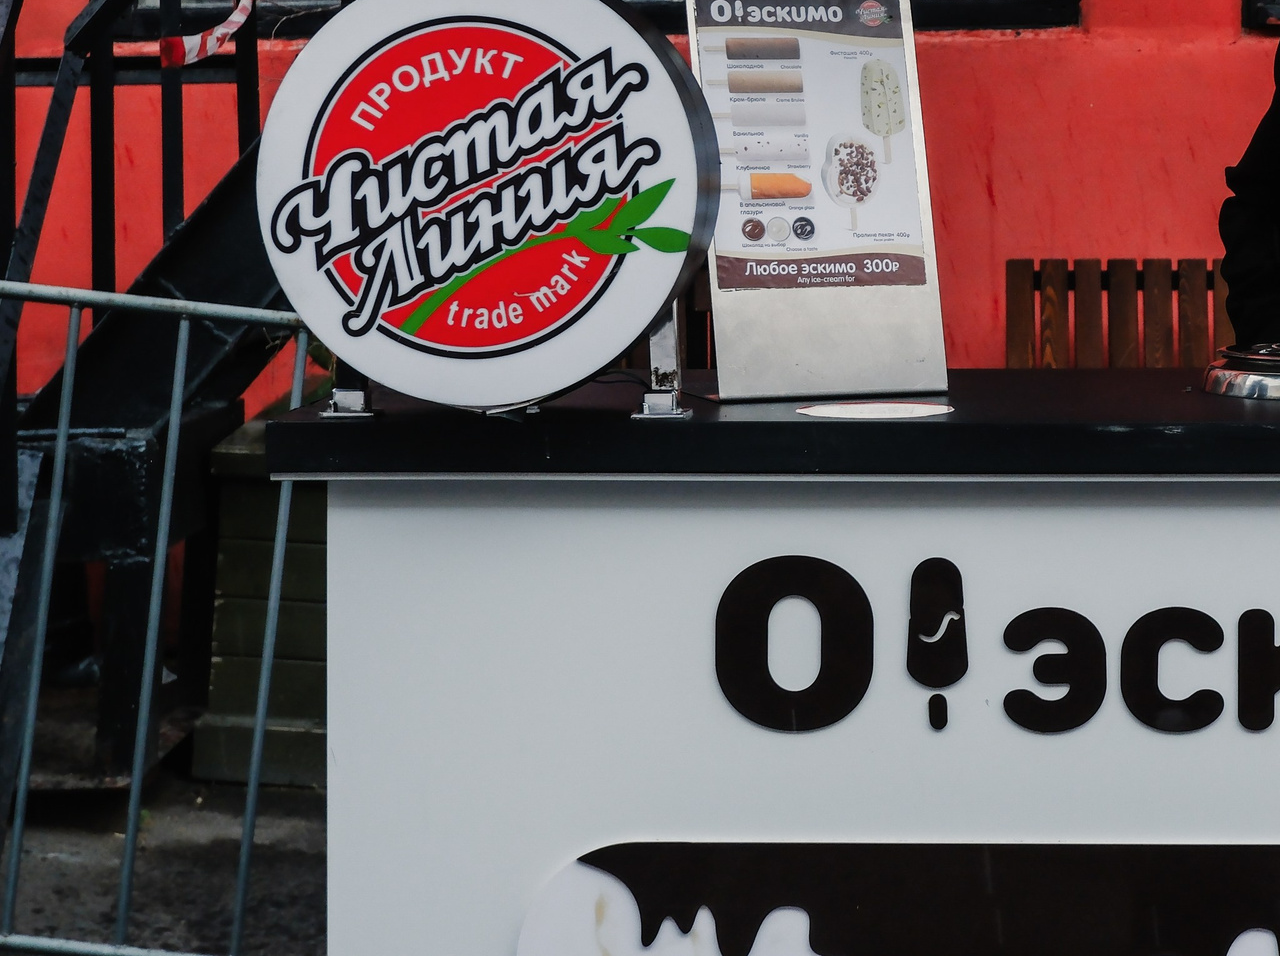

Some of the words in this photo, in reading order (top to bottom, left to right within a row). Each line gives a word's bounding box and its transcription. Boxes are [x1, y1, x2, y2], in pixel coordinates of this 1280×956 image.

[350, 46, 523, 132] ПРОДУКТ
[271, 47, 649, 270] Чистая
[342, 122, 661, 336] Линия
[745, 261, 798, 275] Любое
[801, 262, 856, 274] эскимо
[446, 300, 524, 330] trade
[530, 248, 591, 313] mark
[797, 276, 810, 284] Any
[845, 275, 856, 283] for
